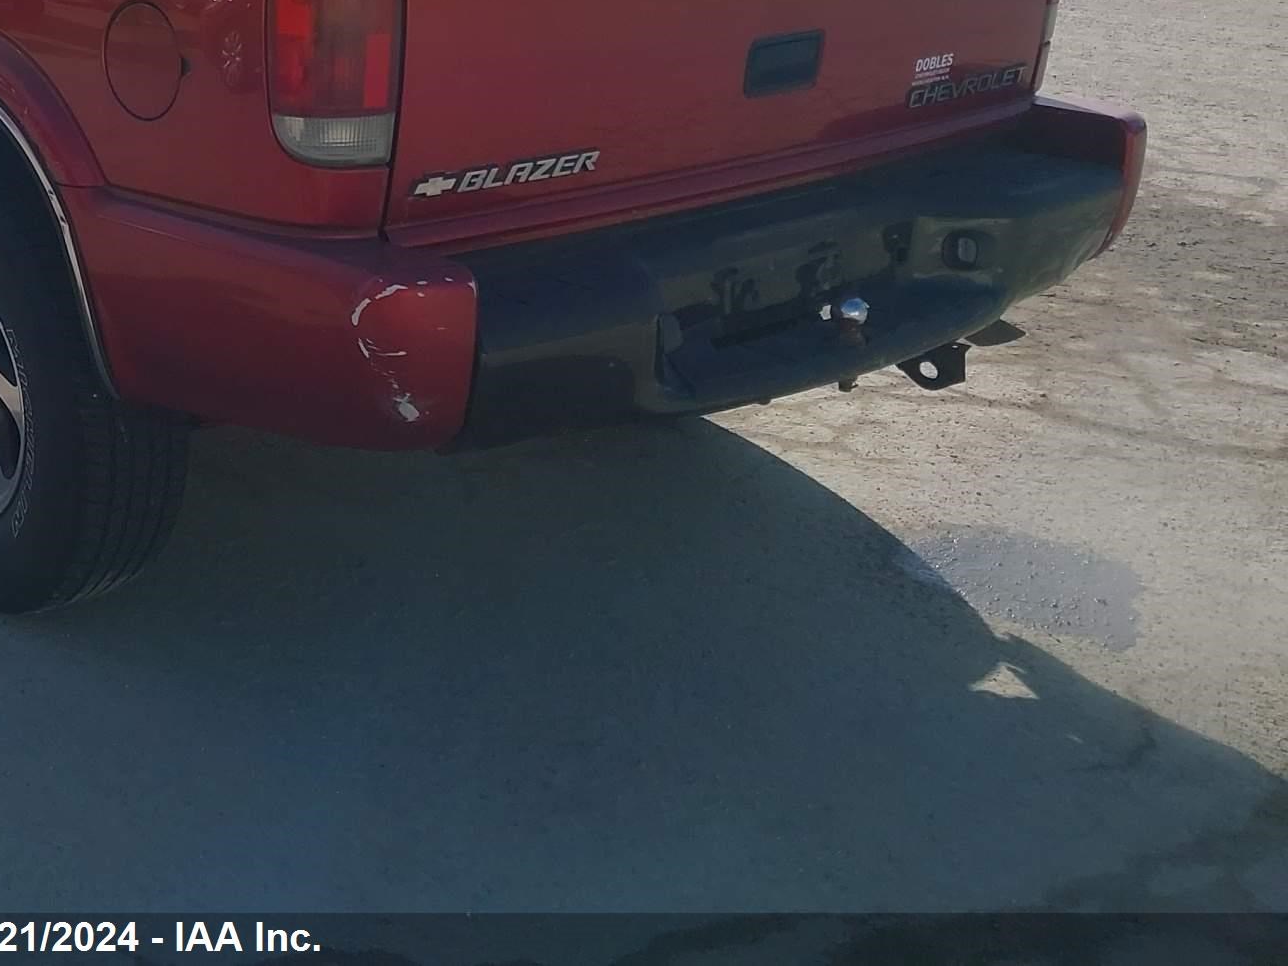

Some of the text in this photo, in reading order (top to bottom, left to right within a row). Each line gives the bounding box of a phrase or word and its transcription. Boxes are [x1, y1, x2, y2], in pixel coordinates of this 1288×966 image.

[915, 53, 954, 73] DOBLES
[909, 65, 1028, 108] CHEVROLET
[457, 150, 601, 193] BLAZER
